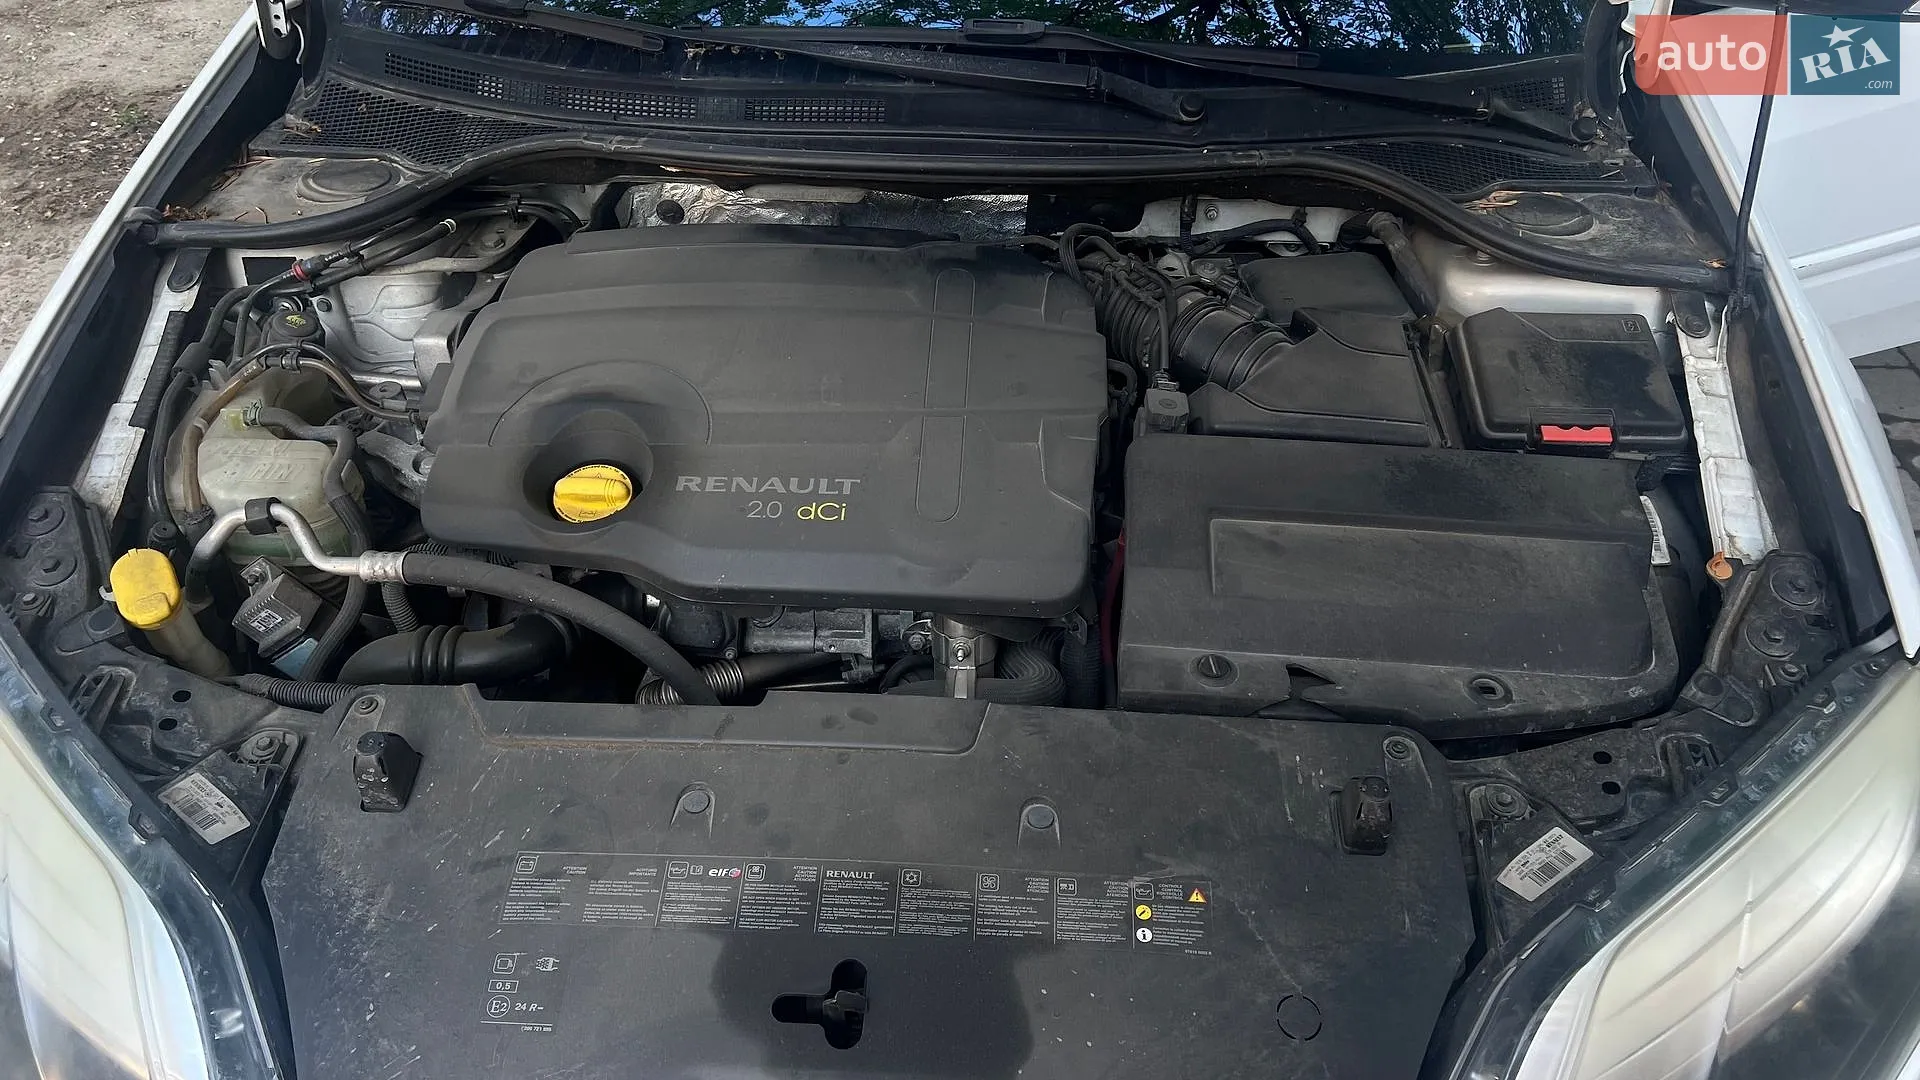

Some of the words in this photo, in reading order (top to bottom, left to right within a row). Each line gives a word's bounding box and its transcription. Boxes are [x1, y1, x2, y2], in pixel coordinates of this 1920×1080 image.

[675, 475, 861, 495] RENAULT
[747, 501, 783, 518] 2.0
[797, 502, 847, 521] dCi
[825, 870, 875, 879] RENAULT
[496, 982, 511, 990] 0,5
[490, 1000, 507, 1013] E2
[514, 1002, 527, 1011] 24
